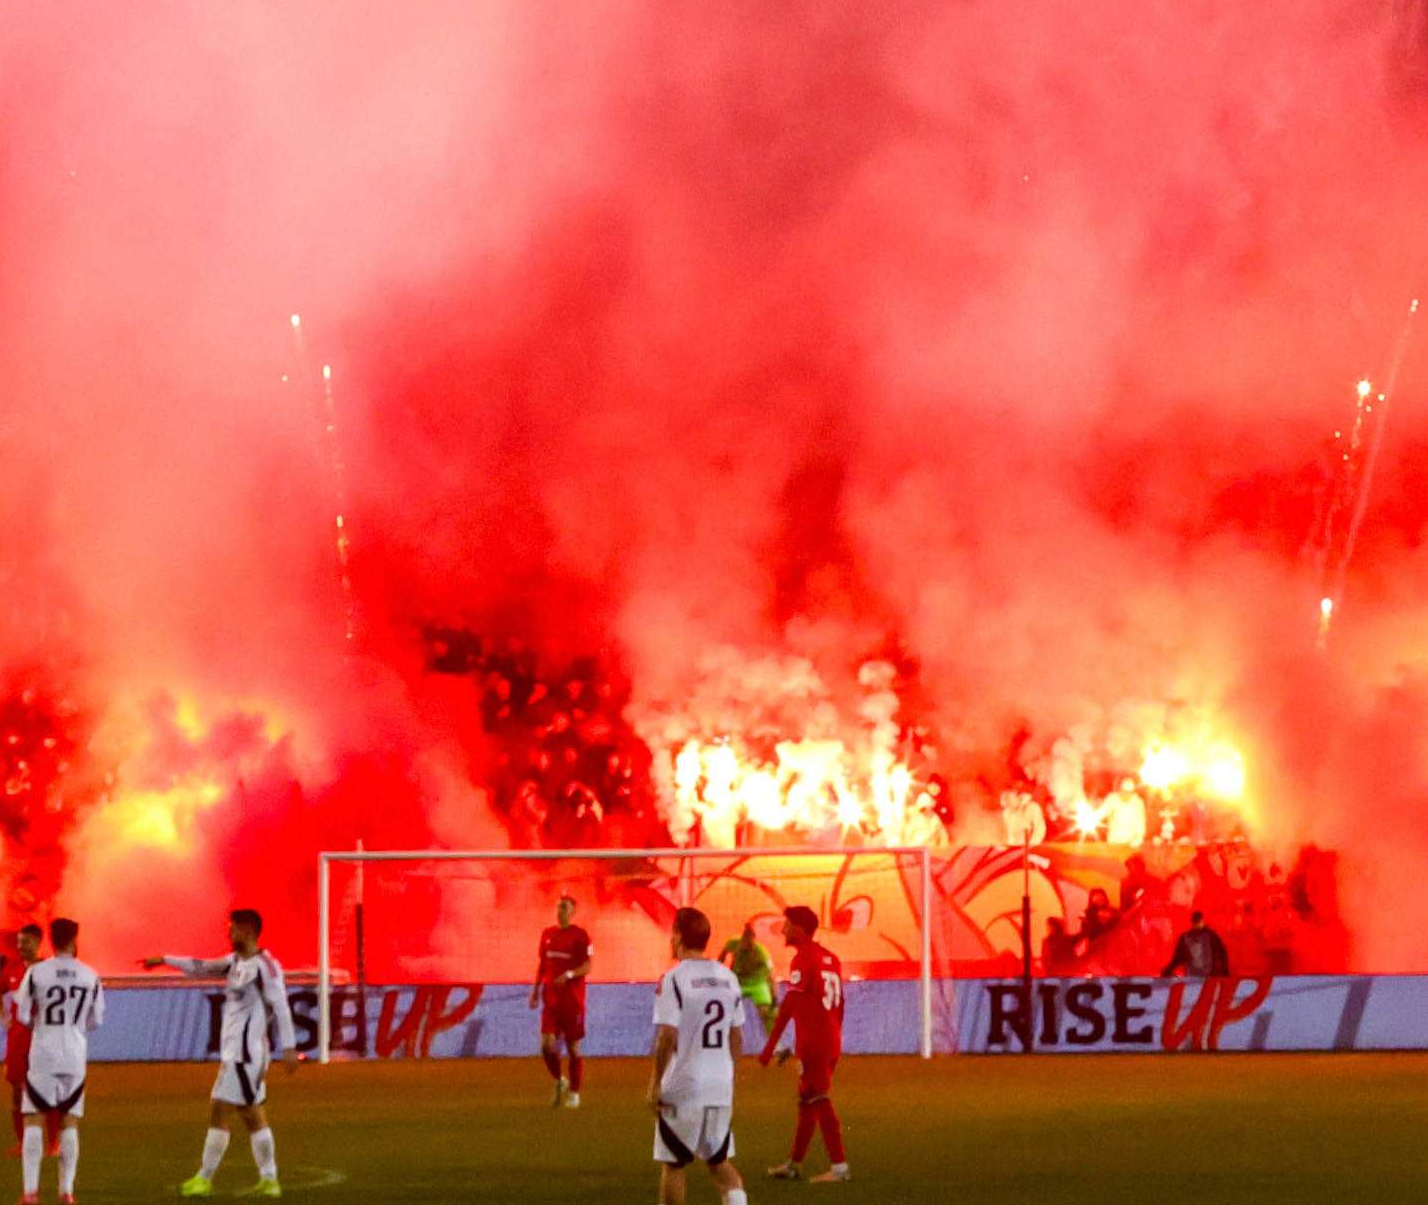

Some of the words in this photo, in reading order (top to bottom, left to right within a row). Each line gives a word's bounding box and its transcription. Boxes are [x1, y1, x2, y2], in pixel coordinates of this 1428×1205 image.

[45, 985, 87, 1026] 27
[374, 983, 484, 1059] UP
[702, 999, 725, 1048] 2
[984, 982, 1154, 1046] RISE
[1161, 975, 1273, 1053] UP
